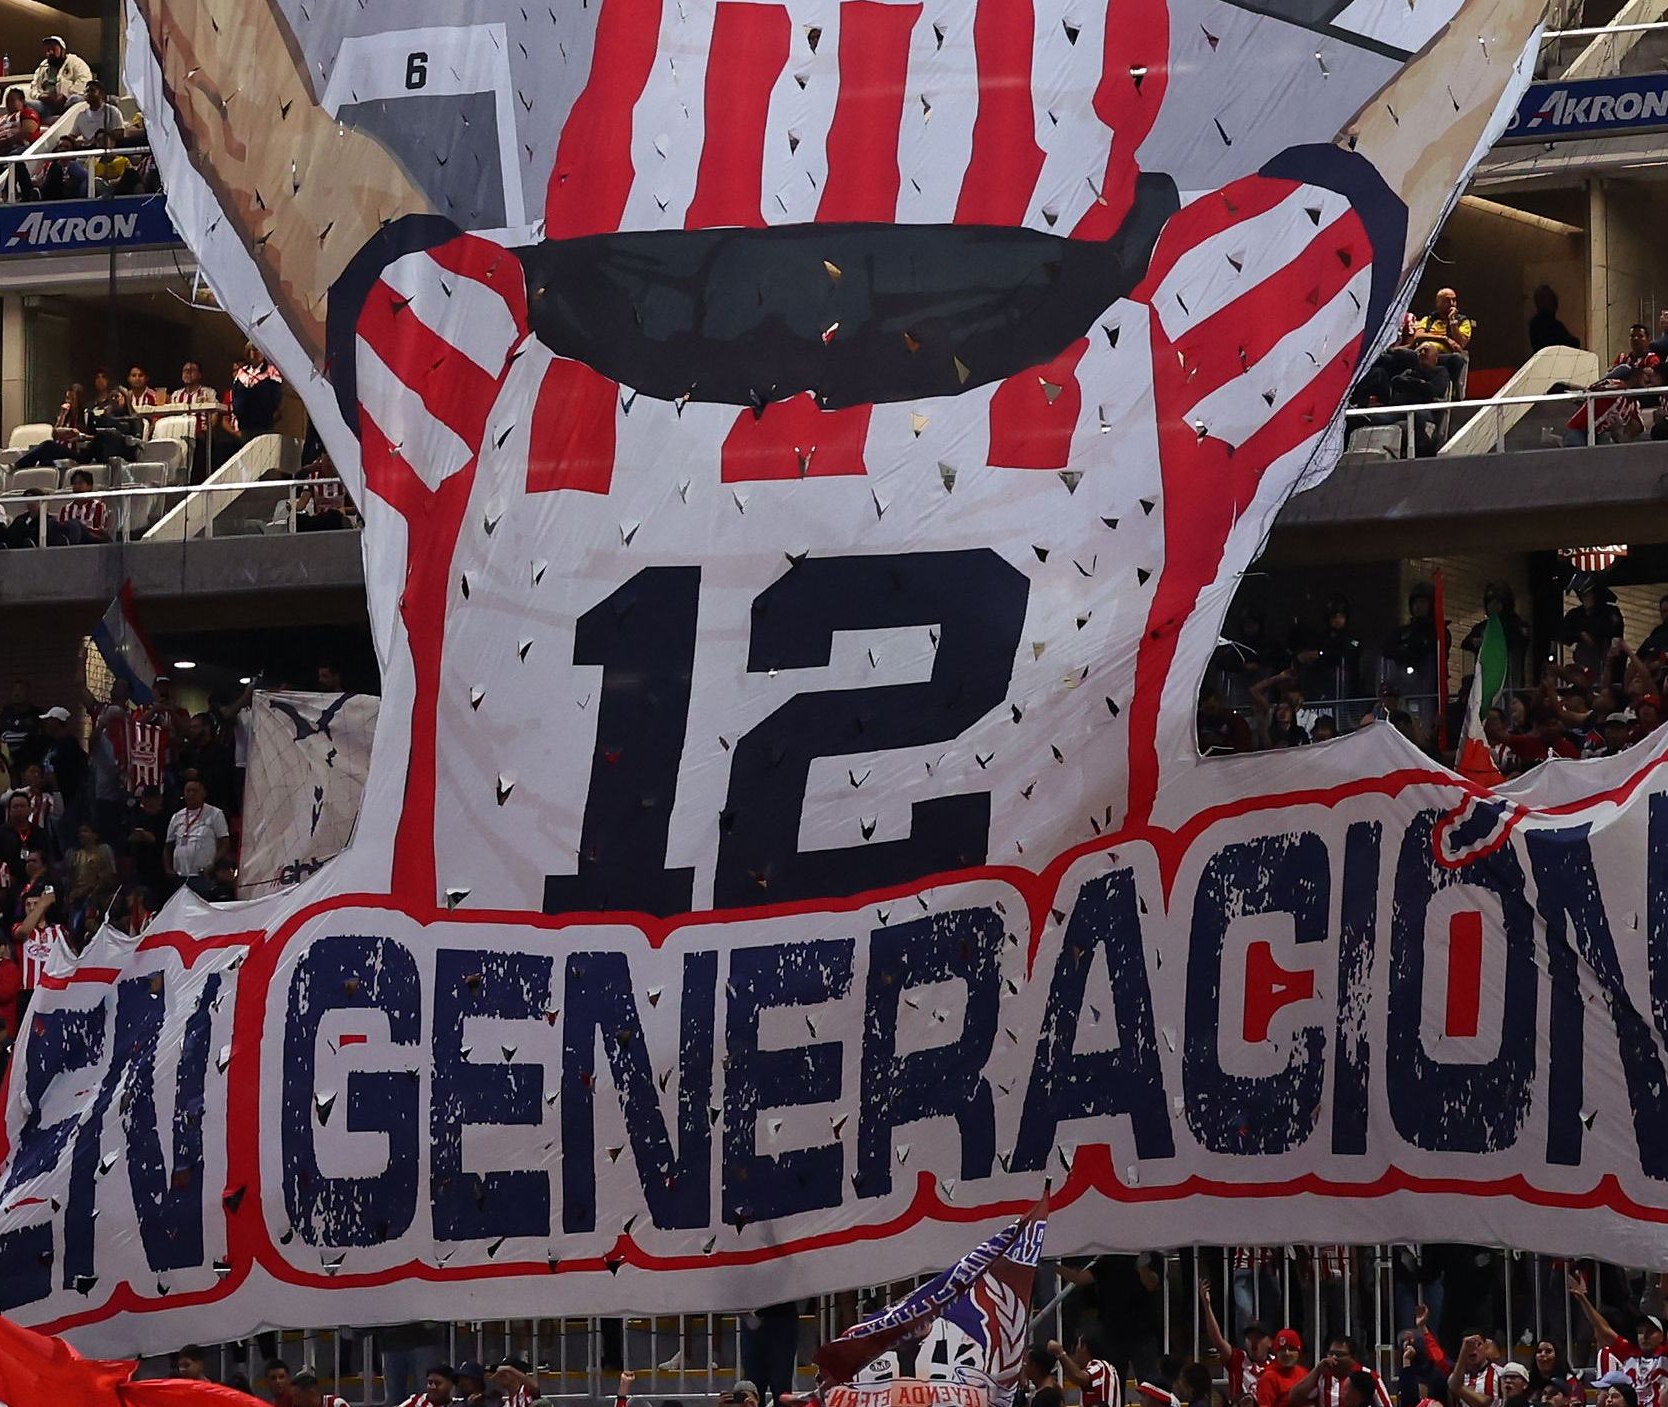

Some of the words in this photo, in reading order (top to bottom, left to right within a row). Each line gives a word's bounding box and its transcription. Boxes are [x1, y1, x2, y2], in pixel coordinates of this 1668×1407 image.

[407, 51, 428, 89] 6
[5, 212, 138, 246] AKRON
[543, 548, 1031, 916] 12
